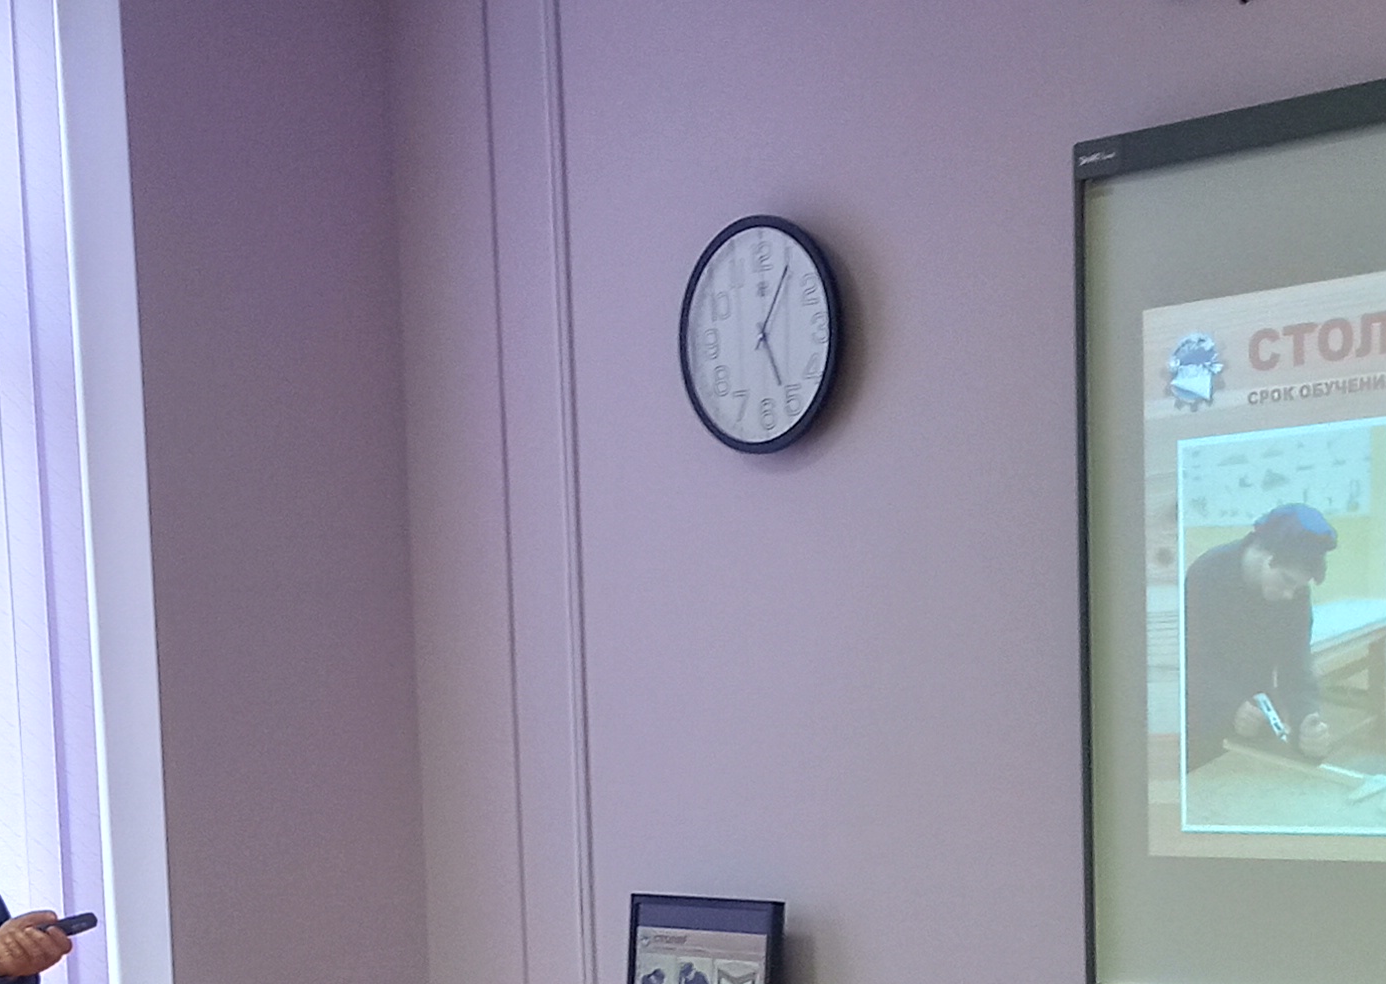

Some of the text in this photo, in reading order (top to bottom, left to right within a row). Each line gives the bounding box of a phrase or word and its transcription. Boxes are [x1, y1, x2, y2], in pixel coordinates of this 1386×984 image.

[800, 273, 820, 306] 2
[811, 311, 828, 344] 3
[704, 328, 719, 360] 9
[714, 365, 730, 397] 8
[1247, 386, 1295, 405] СРОК
[732, 389, 751, 422] 7
[760, 398, 776, 430] 6
[784, 383, 802, 416] 5
